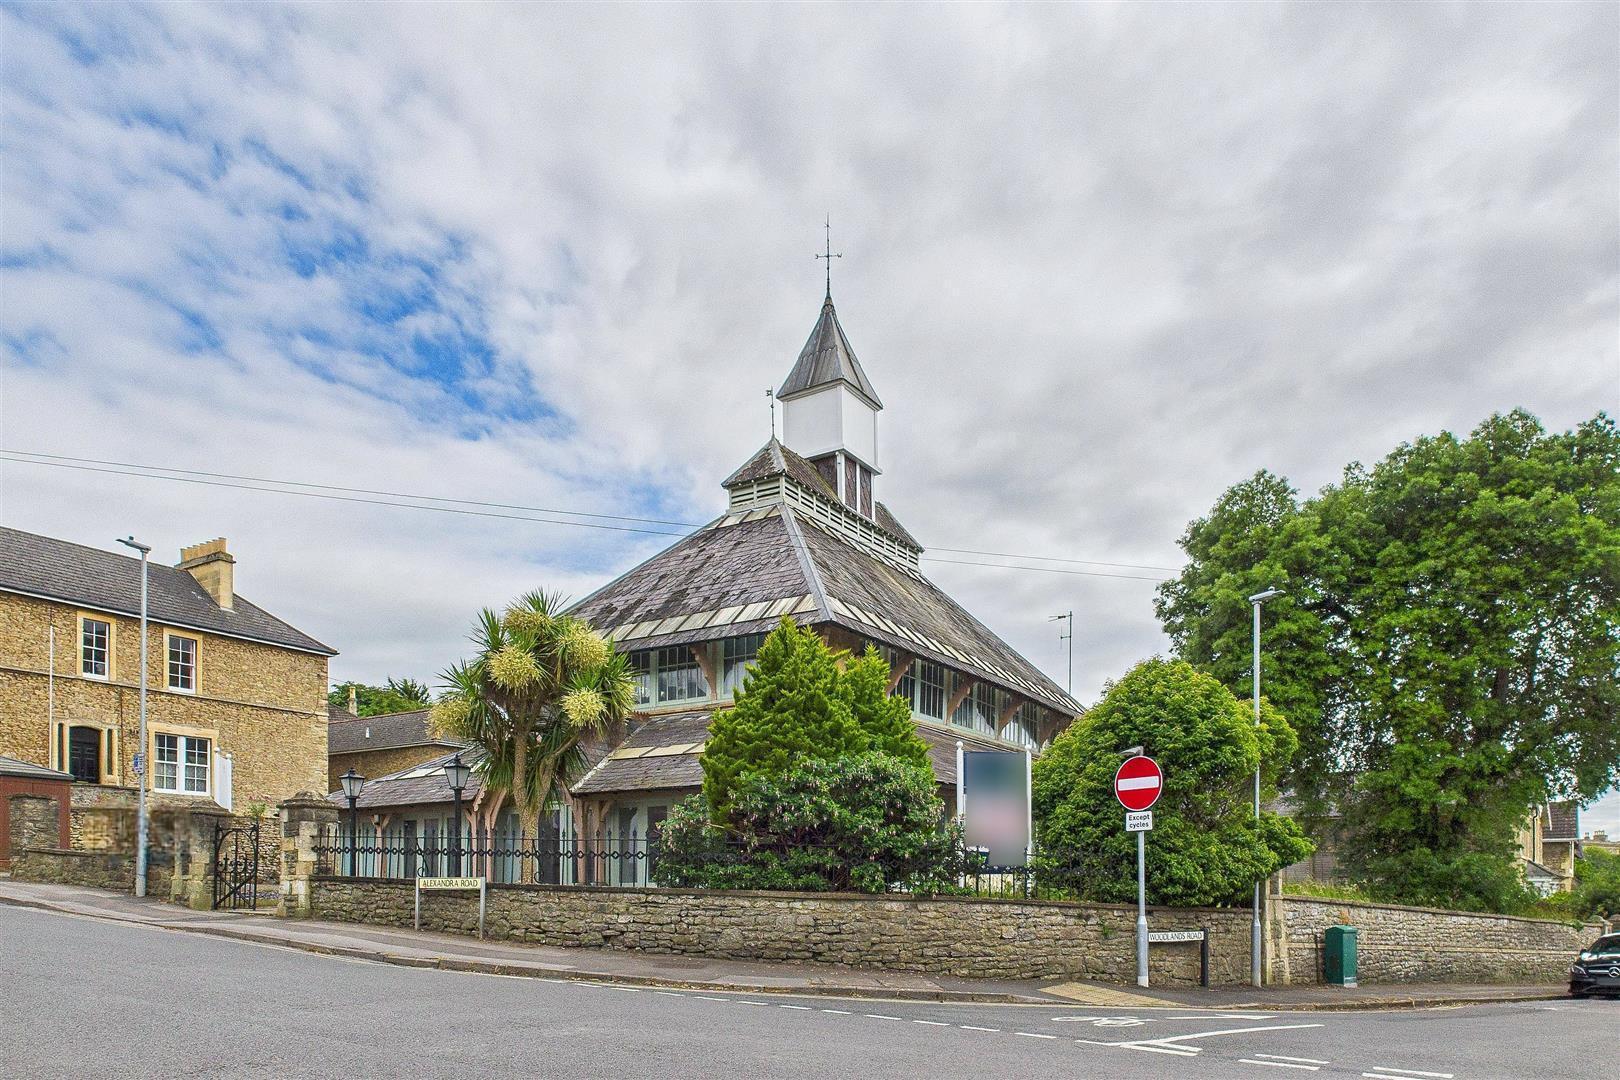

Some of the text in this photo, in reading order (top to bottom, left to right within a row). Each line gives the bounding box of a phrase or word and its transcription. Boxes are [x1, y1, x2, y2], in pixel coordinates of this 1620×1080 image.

[1129, 821, 1149, 829] cycles
[422, 879, 478, 887] ALEXANDRA ROAD
[1149, 932, 1186, 940] WOODLANDS
